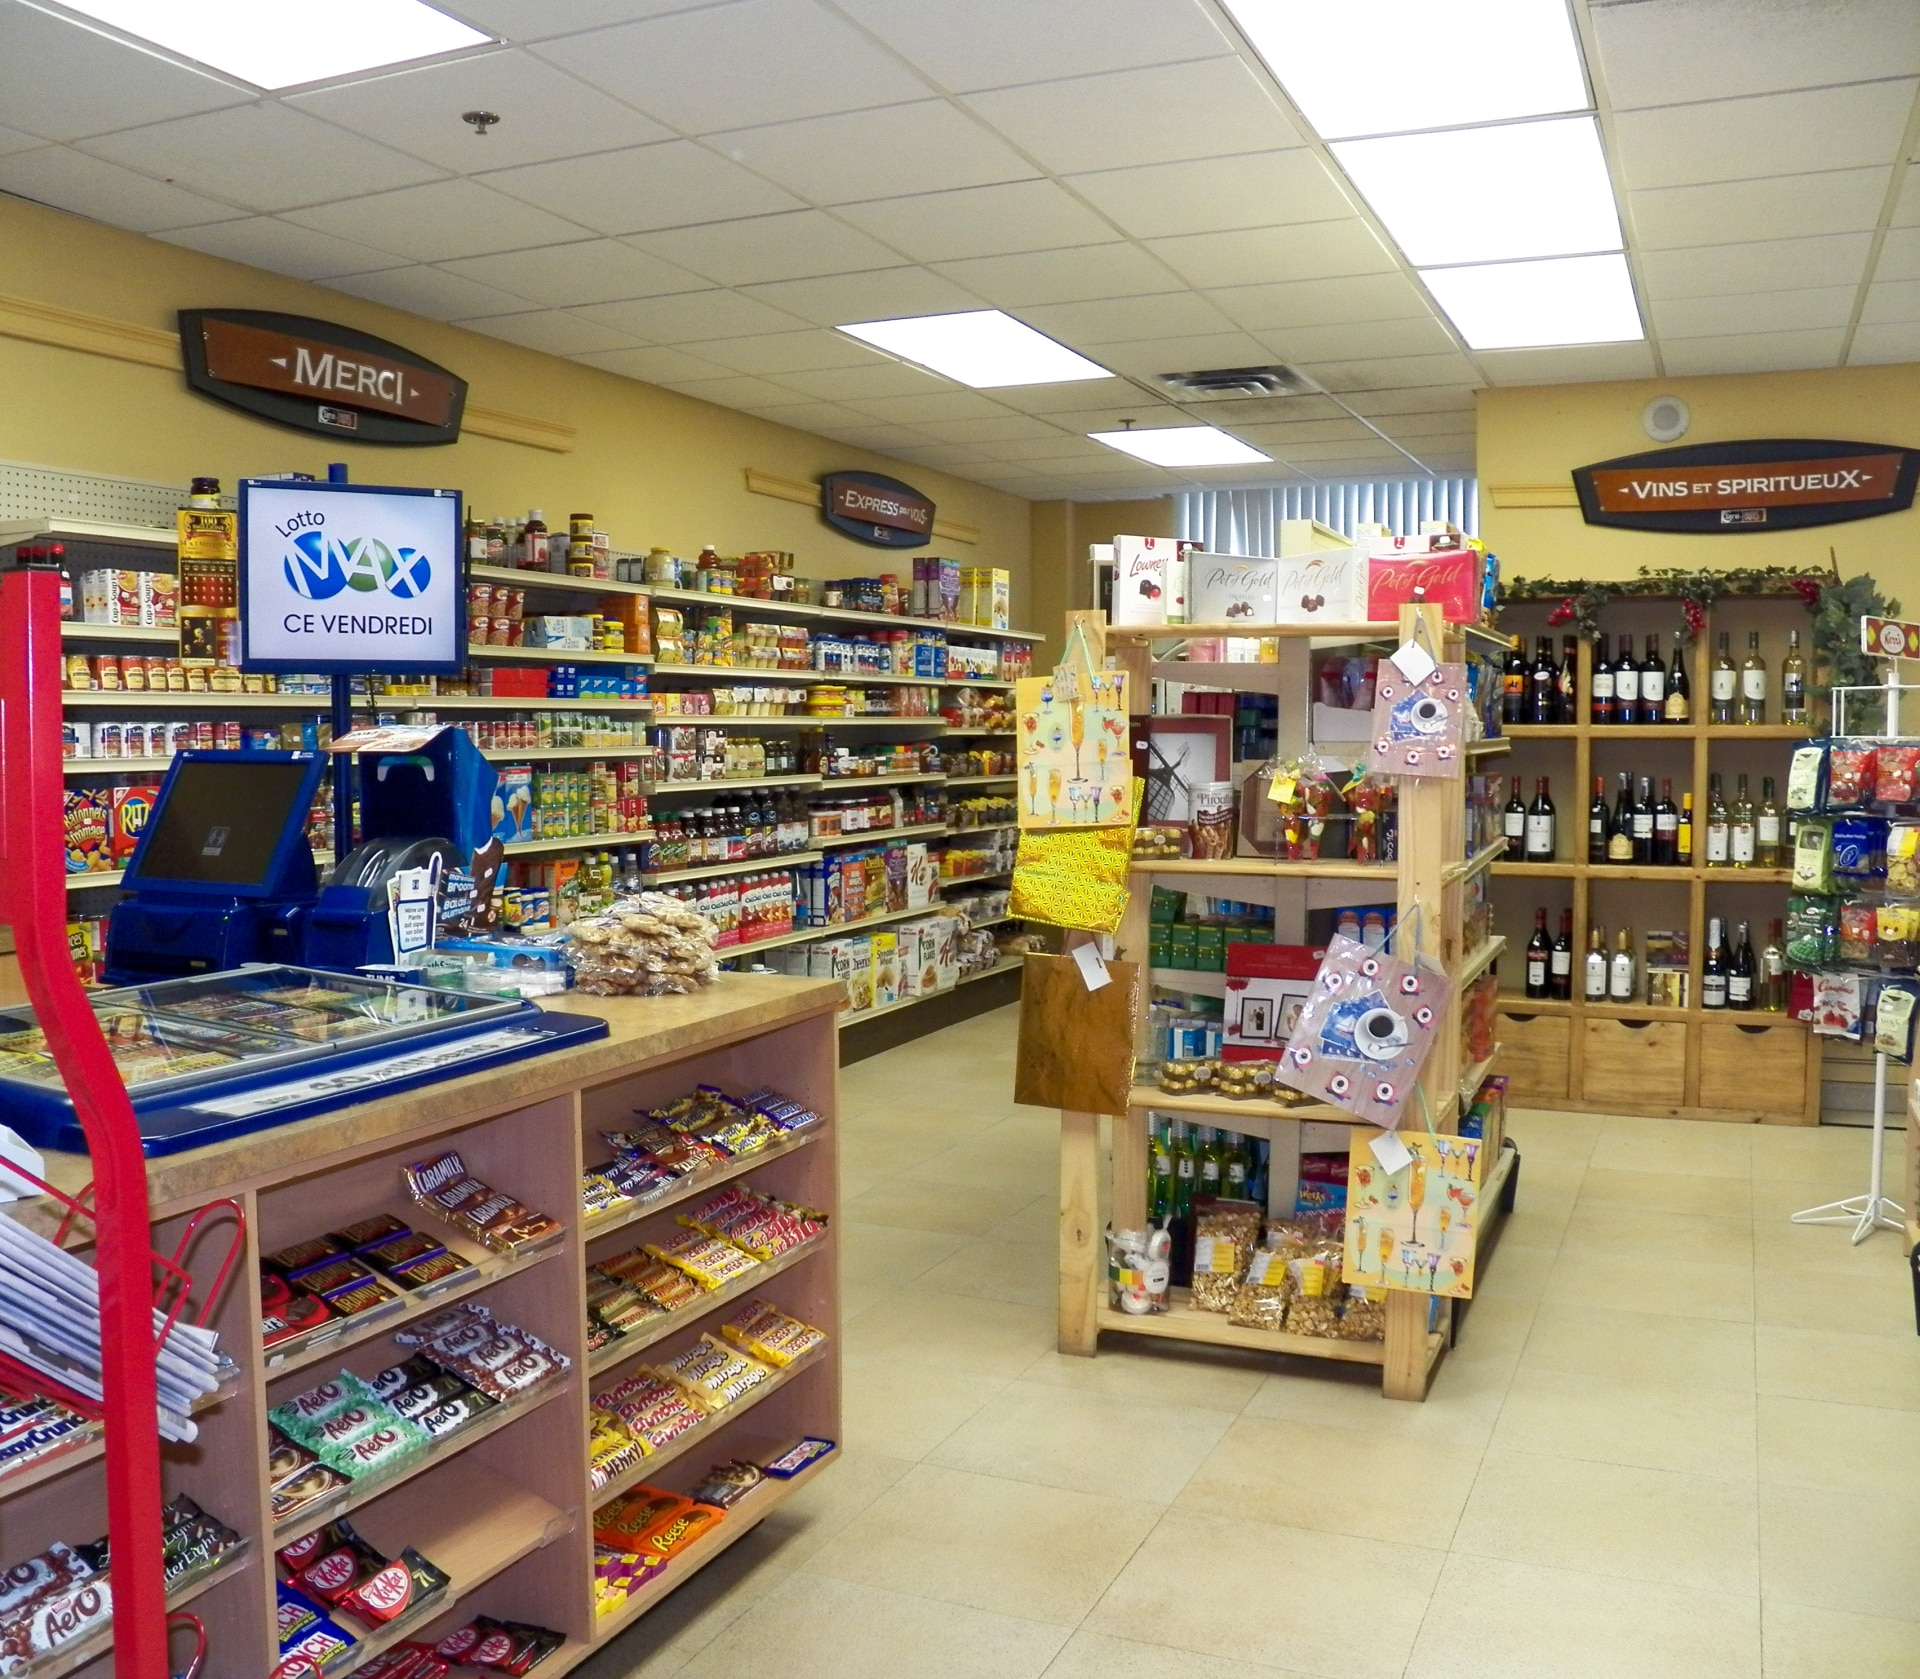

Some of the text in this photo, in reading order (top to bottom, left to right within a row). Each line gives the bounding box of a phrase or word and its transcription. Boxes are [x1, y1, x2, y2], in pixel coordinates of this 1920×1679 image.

[294, 347, 404, 405] MERCI
[1631, 469, 1860, 499] VINS ET SPIRITUEUX
[844, 489, 899, 516] EXPRESS
[275, 510, 325, 538] Lotto
[284, 531, 432, 600] MAX
[1415, 563, 1464, 591] Gold
[284, 613, 432, 635] CE VENDREDI
[416, 1155, 464, 1193] CARAMILK
[435, 1178, 486, 1208] CARAMILK
[465, 1194, 516, 1225] CARAMILK
[334, 1283, 385, 1314] ARAMILK
[673, 1339, 714, 1372] Mirage
[687, 1352, 729, 1382] Mirage
[371, 1369, 400, 1392] ero
[705, 1358, 748, 1390] Mirage
[722, 1367, 766, 1402] Mirage
[631, 1398, 688, 1435] Crunchie
[650, 1408, 706, 1448] Crunchie
[651, 1517, 690, 1552] Reese
[0, 1563, 36, 1597] ero
[372, 1572, 404, 1605] KitKat
[46, 1587, 101, 1647] Aero
